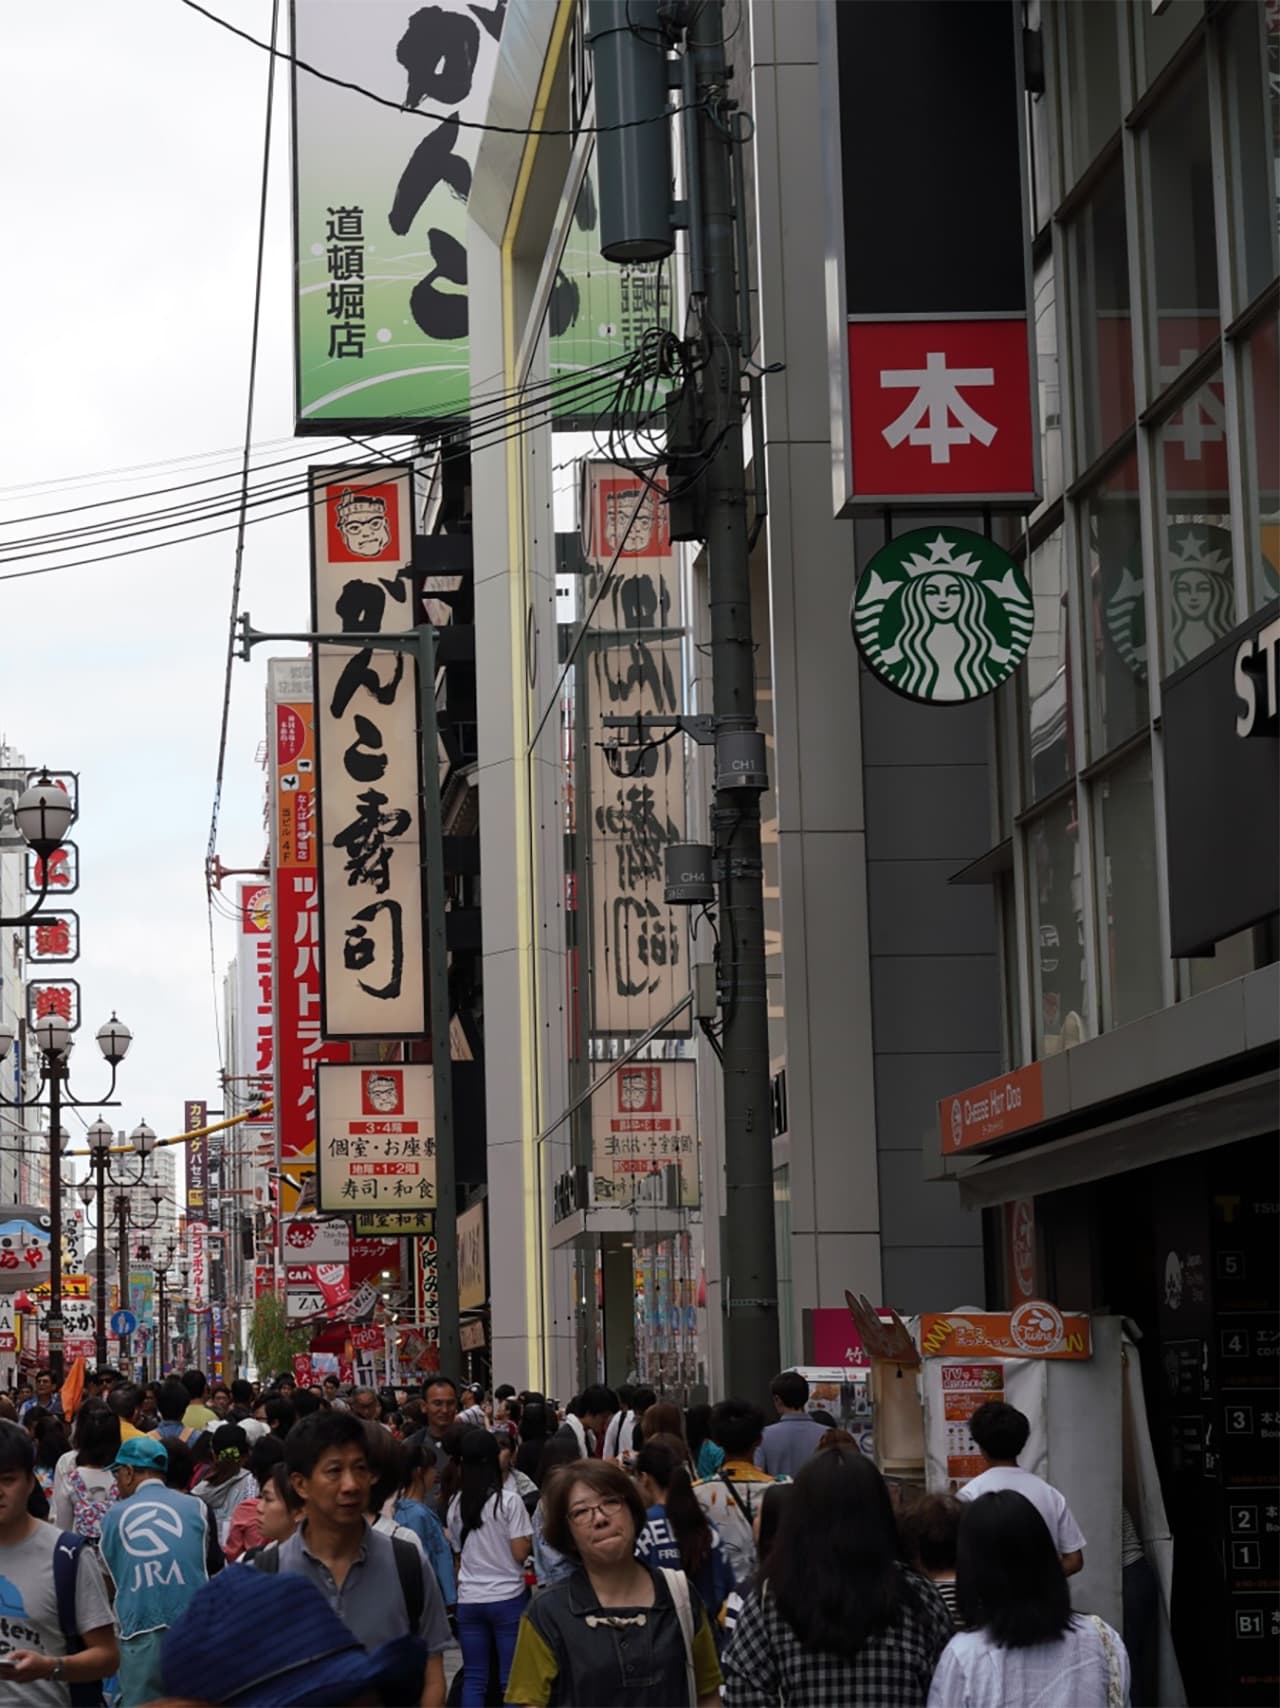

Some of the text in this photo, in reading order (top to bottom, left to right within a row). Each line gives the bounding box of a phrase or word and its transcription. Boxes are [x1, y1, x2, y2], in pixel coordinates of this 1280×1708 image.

[324, 205, 366, 360] 道頓堀店
[880, 352, 998, 464] 本
[731, 759, 755, 770] CH1
[680, 872, 705, 883] CH4
[365, 1121, 403, 1134] 3・4階
[189, 1103, 204, 1188] カラケパセラ
[341, 1178, 434, 1200] 寿司・和食
[359, 1213, 427, 1228] 個室・和食
[1225, 1257, 1238, 1273] 5
[1228, 1335, 1242, 1352] 4
[1232, 1411, 1246, 1429] 3
[1237, 1510, 1251, 1528] 2
[1240, 1546, 1250, 1564] 1
[130, 1559, 186, 1593] JRA
[1239, 1616, 1261, 1633] B1
